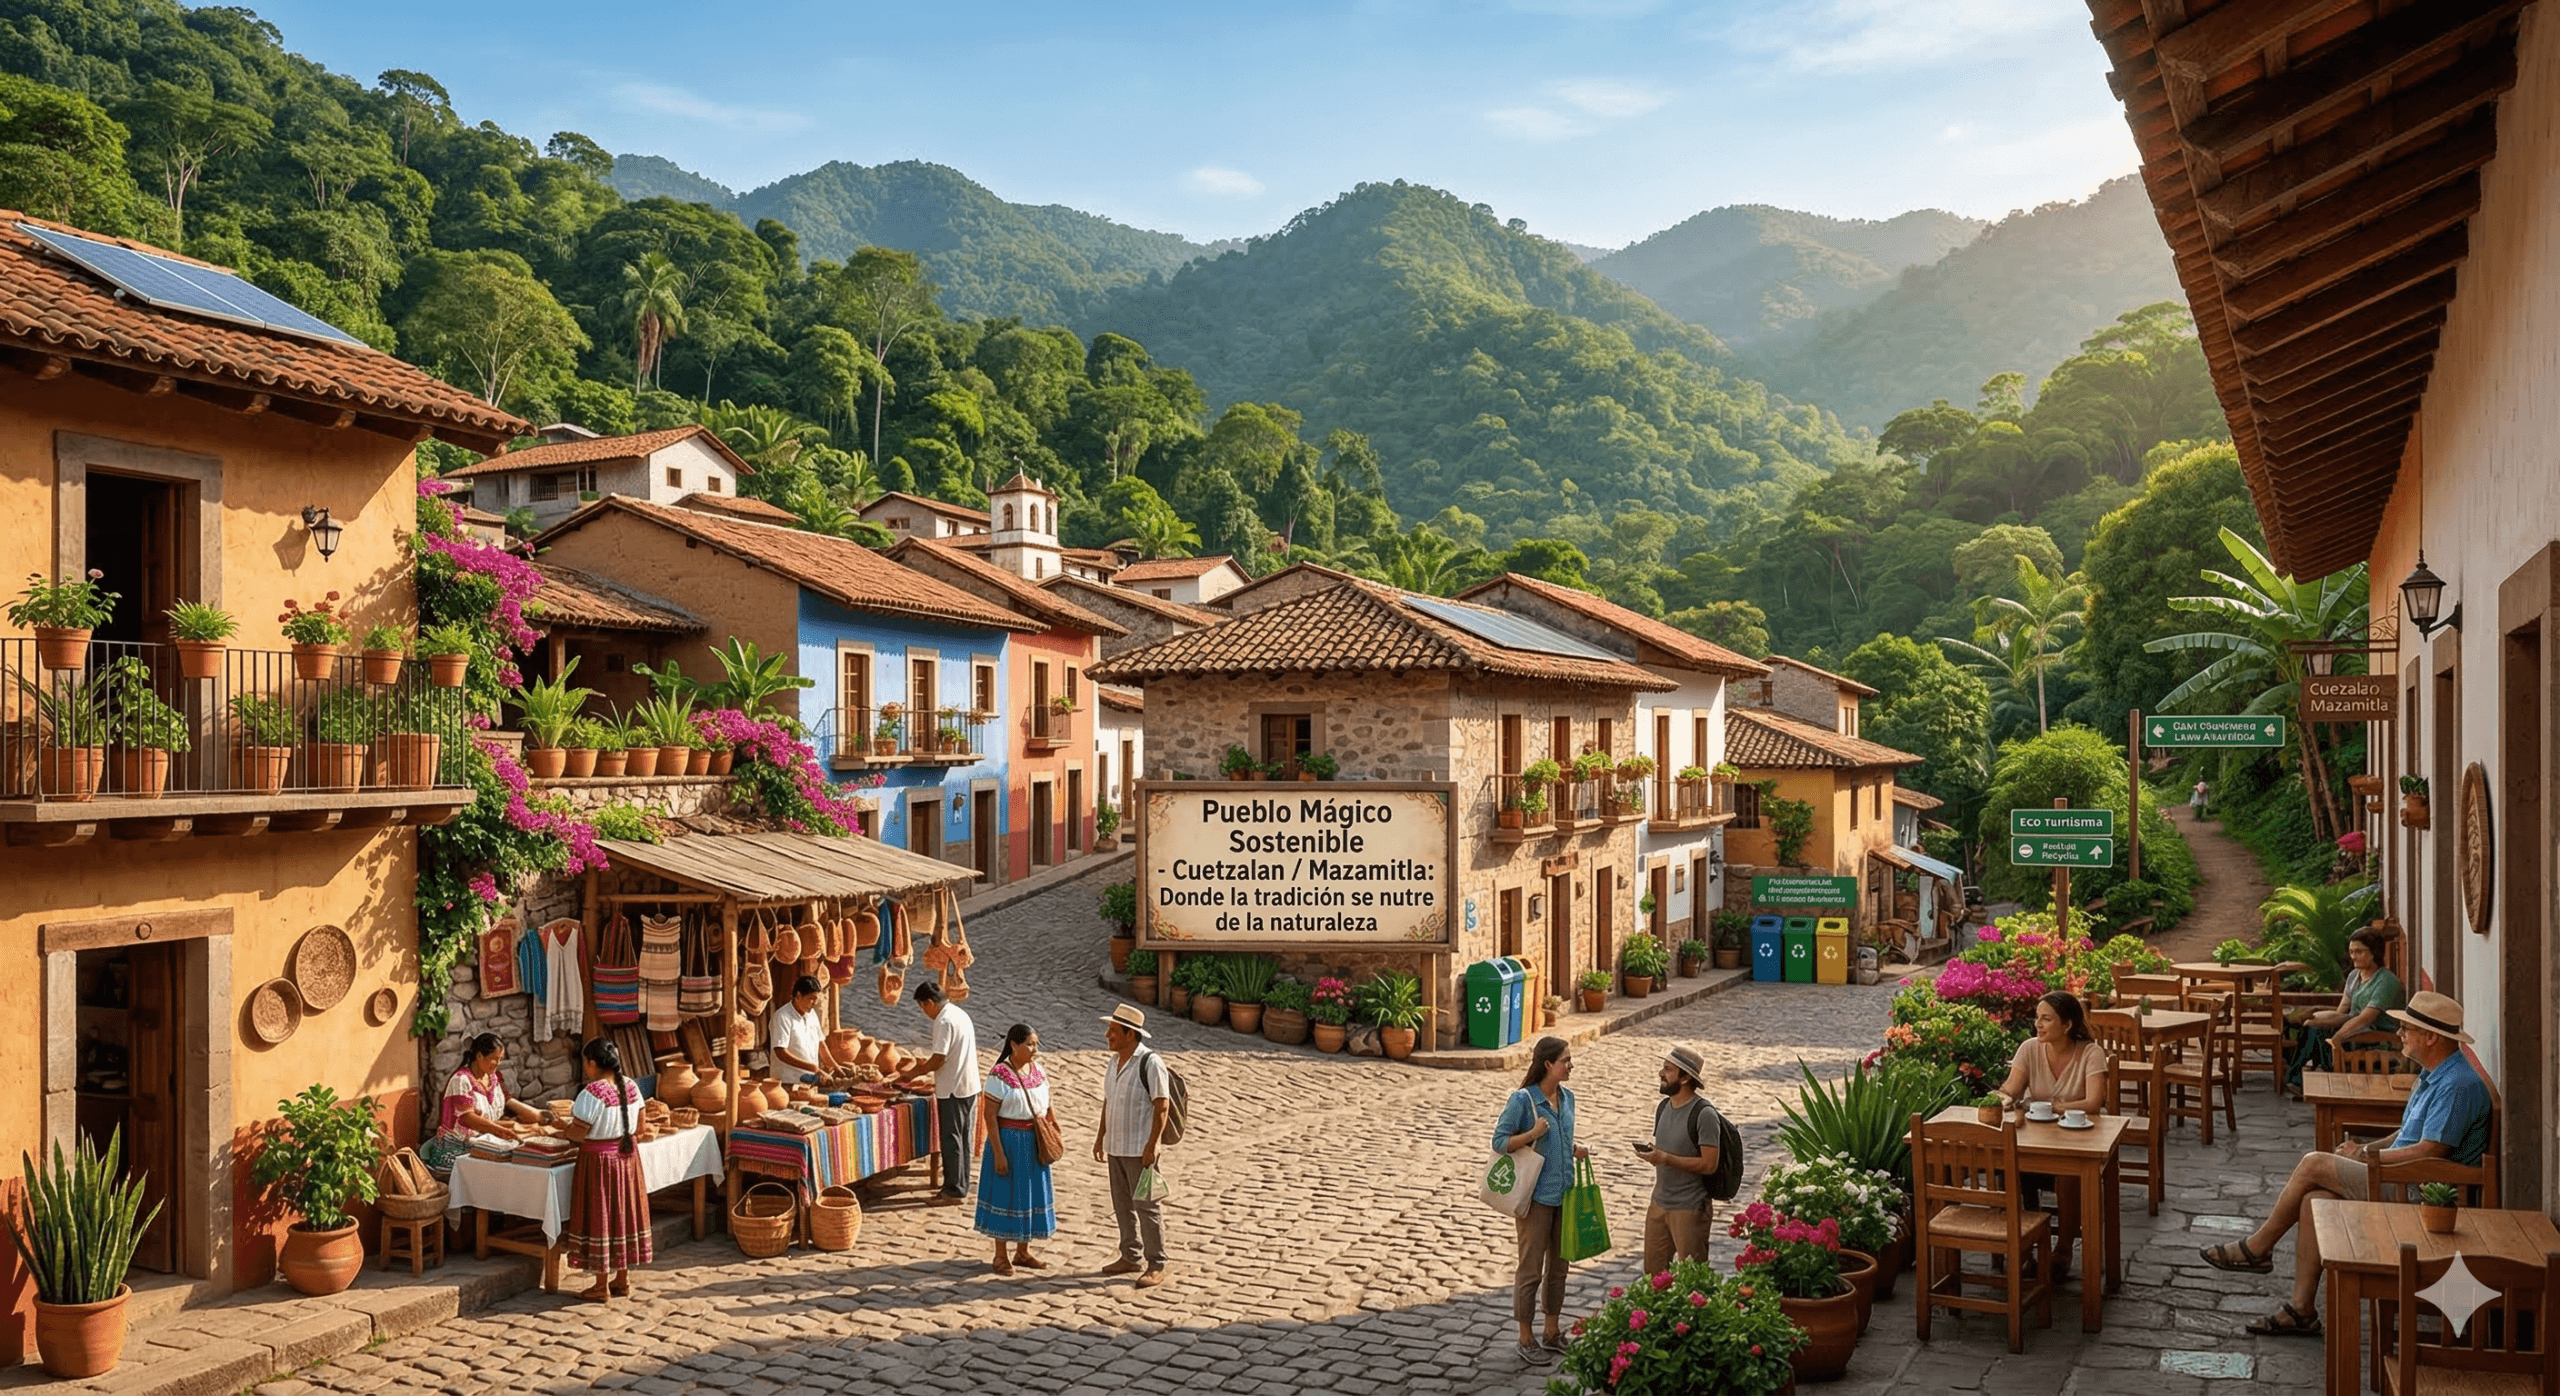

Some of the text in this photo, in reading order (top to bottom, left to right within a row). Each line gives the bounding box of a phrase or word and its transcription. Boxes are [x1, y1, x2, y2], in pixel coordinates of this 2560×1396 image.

[2310, 697, 2389, 712] Mazamitla
[1203, 797, 1393, 829] Pueblo Mágico
[1229, 829, 1364, 854] Sostenible
[1172, 858, 1285, 881] Cuetzalan
[1291, 858, 1303, 882] /
[1309, 858, 1435, 881] Mazamitla:
[1160, 886, 1434, 907] Donde la tradición se nutre
[1215, 911, 1378, 932] de la naturaleza
